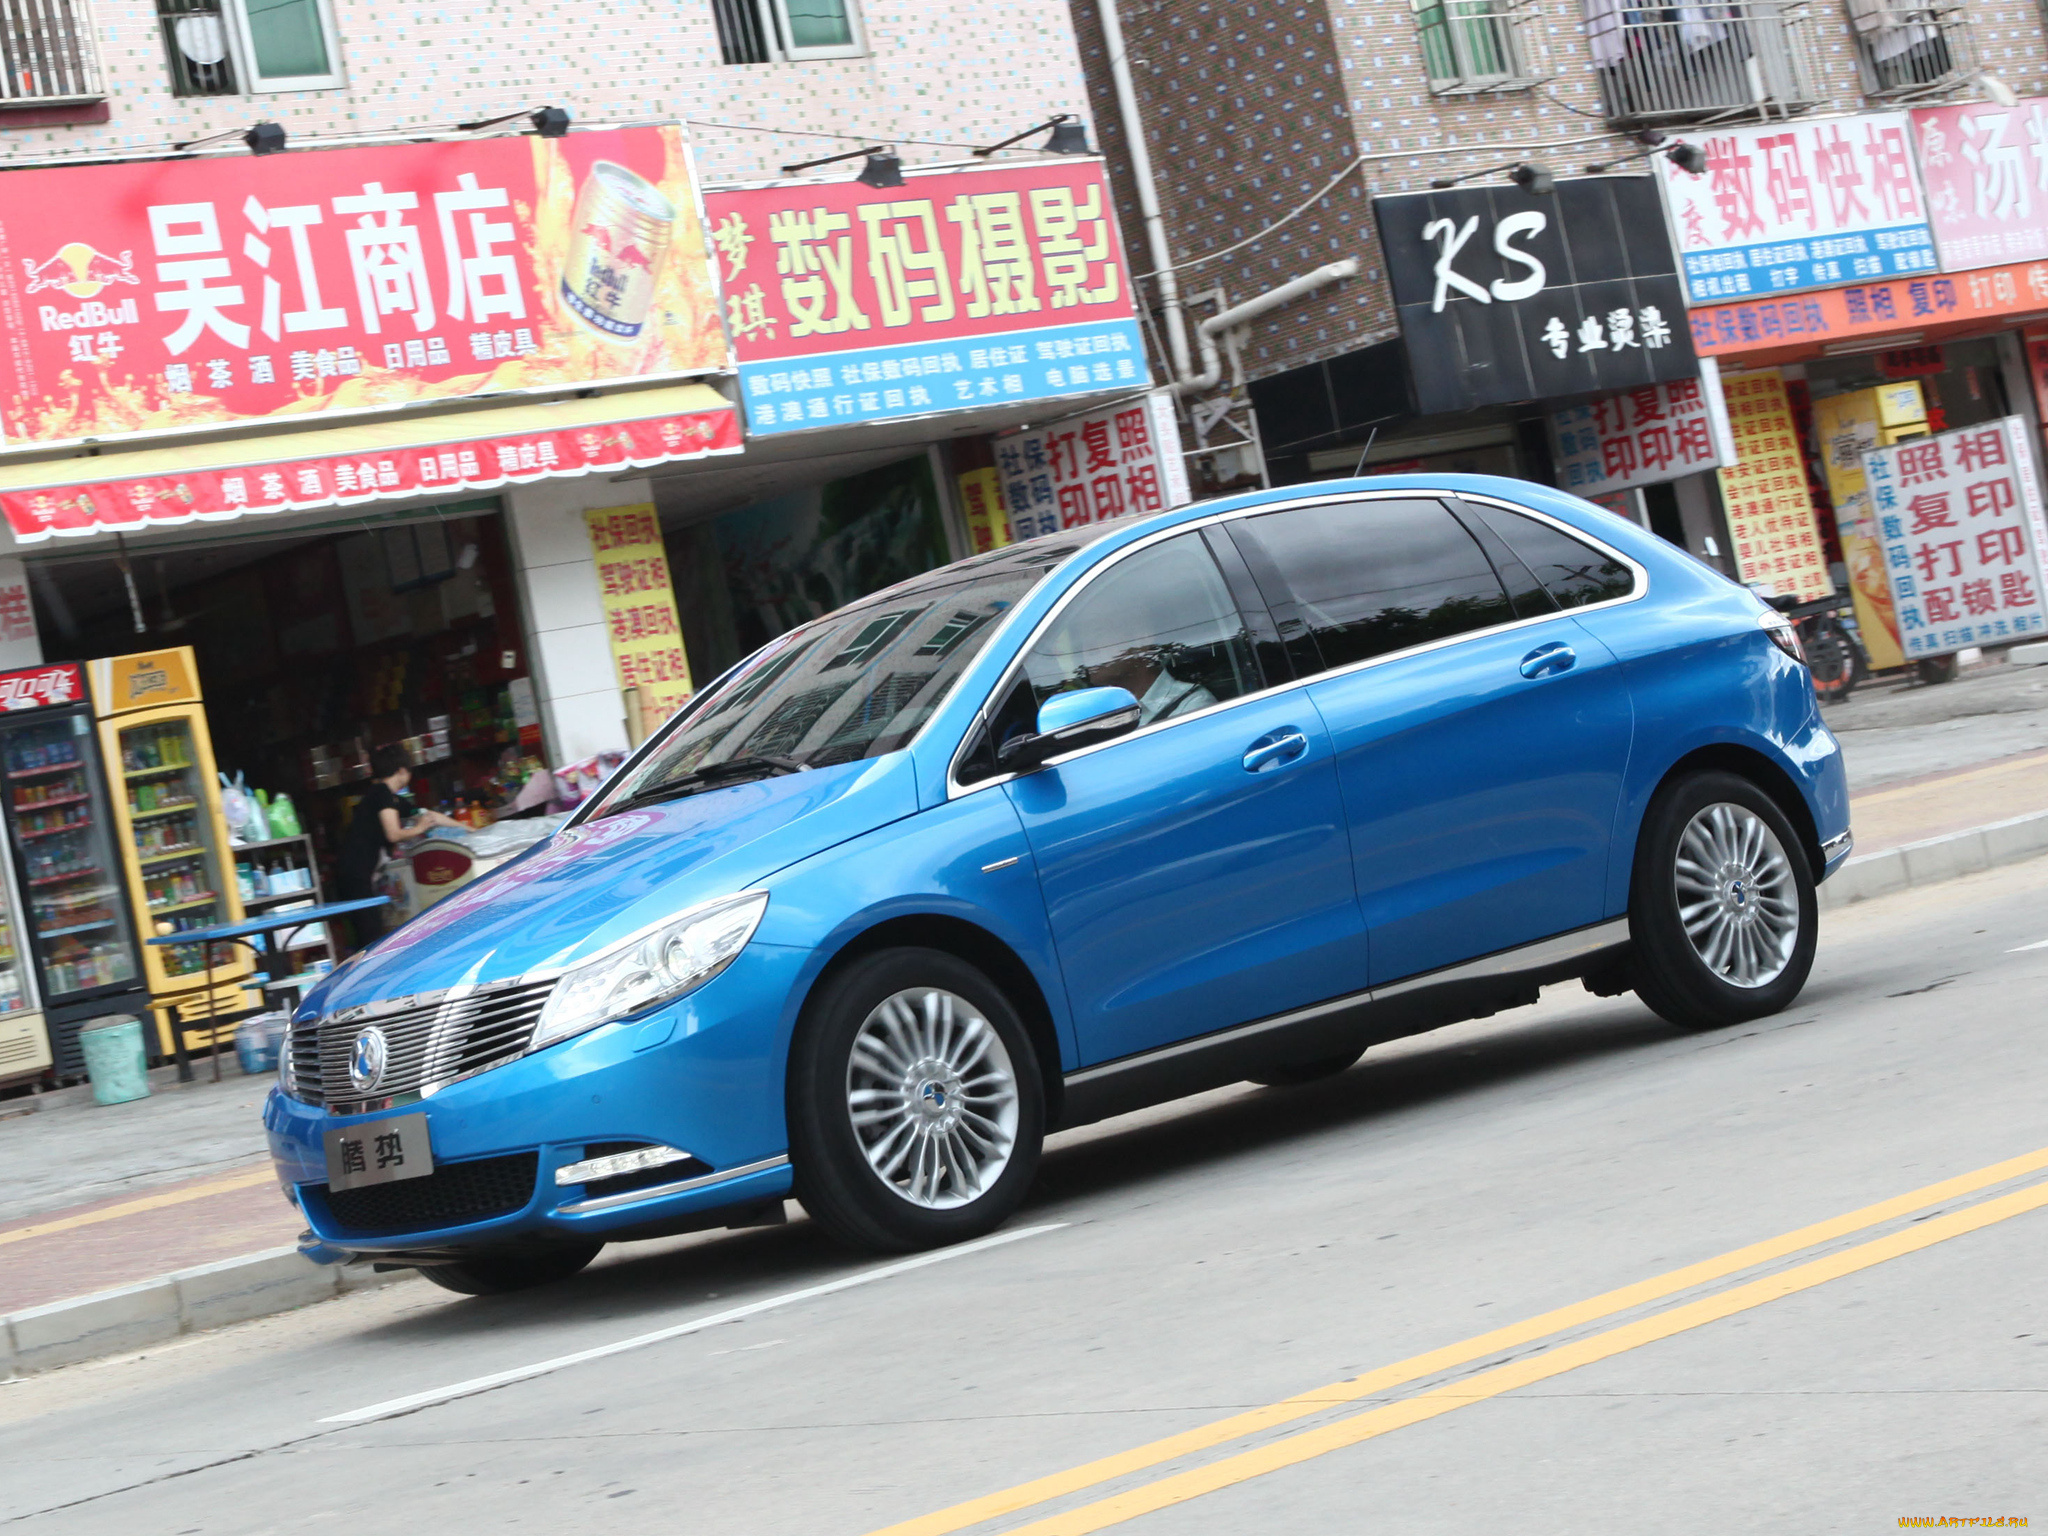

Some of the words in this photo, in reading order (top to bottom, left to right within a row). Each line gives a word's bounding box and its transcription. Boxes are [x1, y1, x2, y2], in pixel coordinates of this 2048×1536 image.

[1704, 123, 1921, 241] 数码快相
[146, 172, 527, 356] 吴江商店
[769, 183, 1120, 338] 数码摄影
[1422, 211, 1547, 313] KS
[38, 298, 139, 332] RedBull
[1540, 305, 1673, 360] 专业烫染
[1690, 297, 1829, 349] 社保数码回执
[1845, 287, 1897, 325] 照相
[1908, 279, 1956, 318] 复印
[1968, 271, 2017, 310] 打印
[68, 331, 124, 362] 红牛
[206, 358, 233, 389] 茶
[248, 355, 275, 384] 酒
[383, 337, 451, 370] 日用品
[748, 366, 832, 396] 数码快照
[841, 353, 963, 386] 社保数码回执
[969, 344, 1028, 370] 居住证
[1036, 332, 1132, 361] 驾驶证回执
[755, 385, 932, 426] 港澳通行证回执
[953, 374, 1023, 401] 艺术相
[260, 473, 285, 500] 茶
[298, 468, 324, 495] 酒
[419, 451, 480, 482] 日用品
[1896, 429, 2008, 488] 照相
[1906, 477, 2017, 535] 复印
[1913, 526, 2026, 582] 打印
[1922, 570, 2036, 625] 配锁匙
[341, 1133, 405, 1175] 腾势
